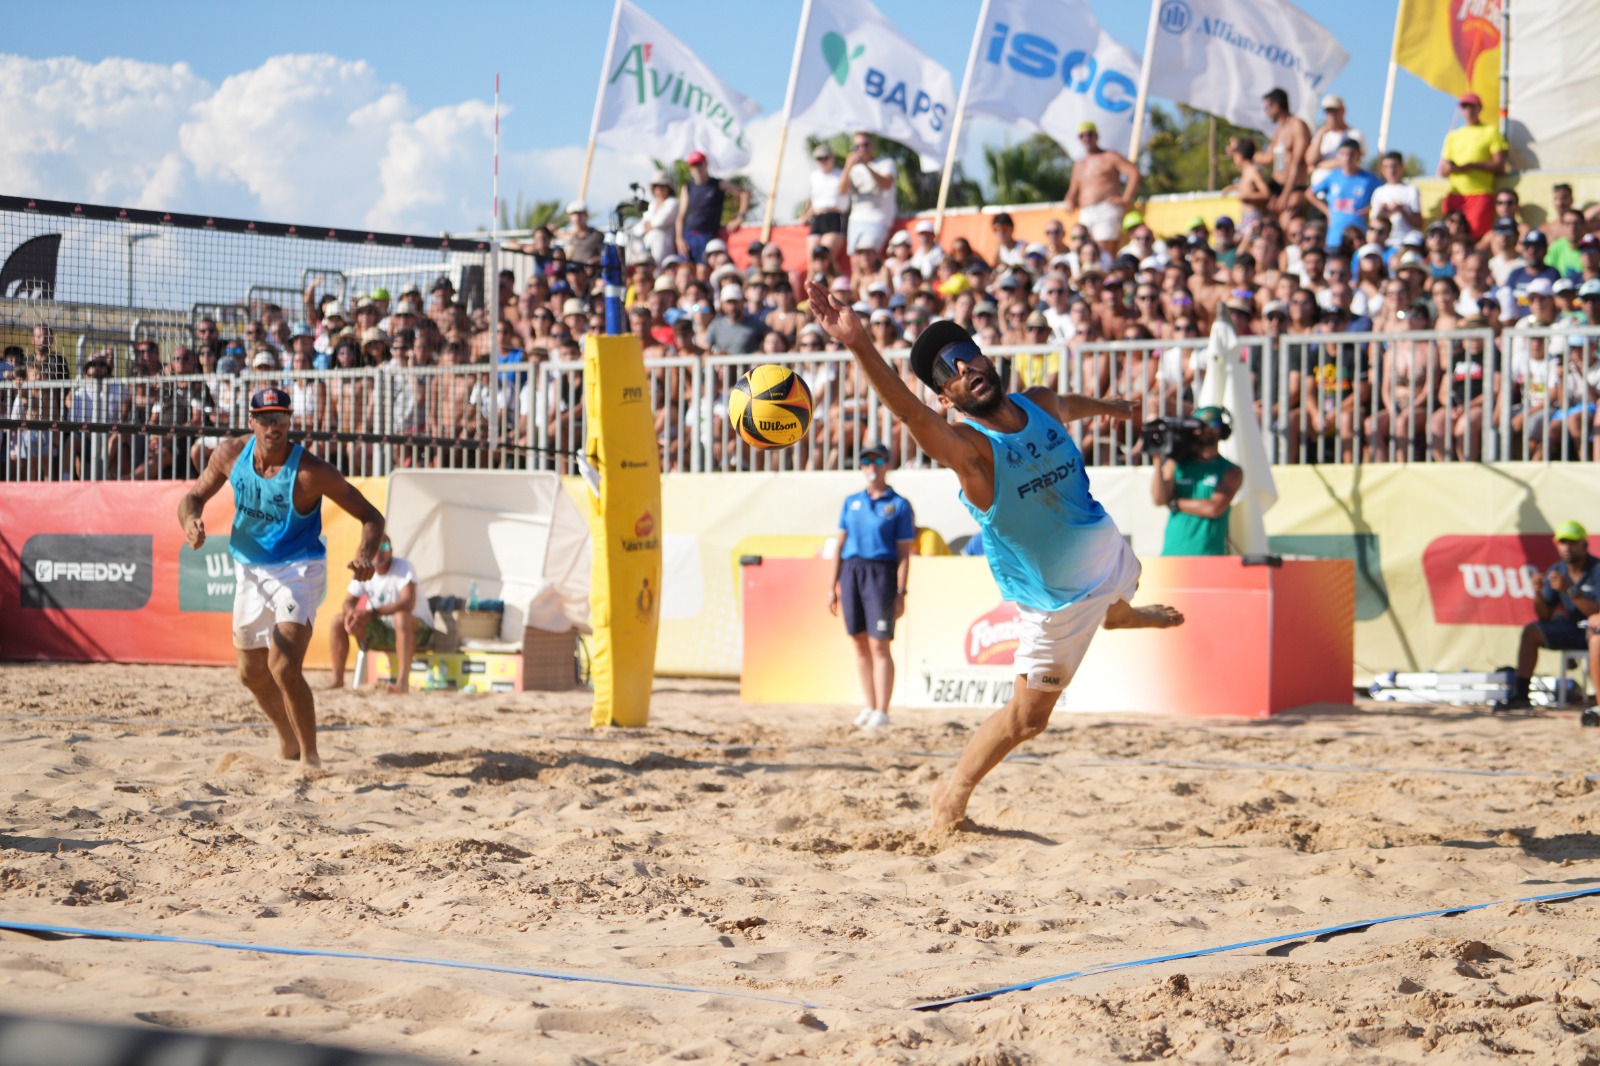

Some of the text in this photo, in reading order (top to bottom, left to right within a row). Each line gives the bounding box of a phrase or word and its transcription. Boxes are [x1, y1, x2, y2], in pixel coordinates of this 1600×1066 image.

[865, 72, 946, 132] BAPS
[758, 420, 797, 432] Wilson
[1026, 442, 1041, 460] 2
[1017, 458, 1077, 499] FREDDY
[53, 561, 137, 582] FREDDY
[933, 679, 988, 705] BEACH
